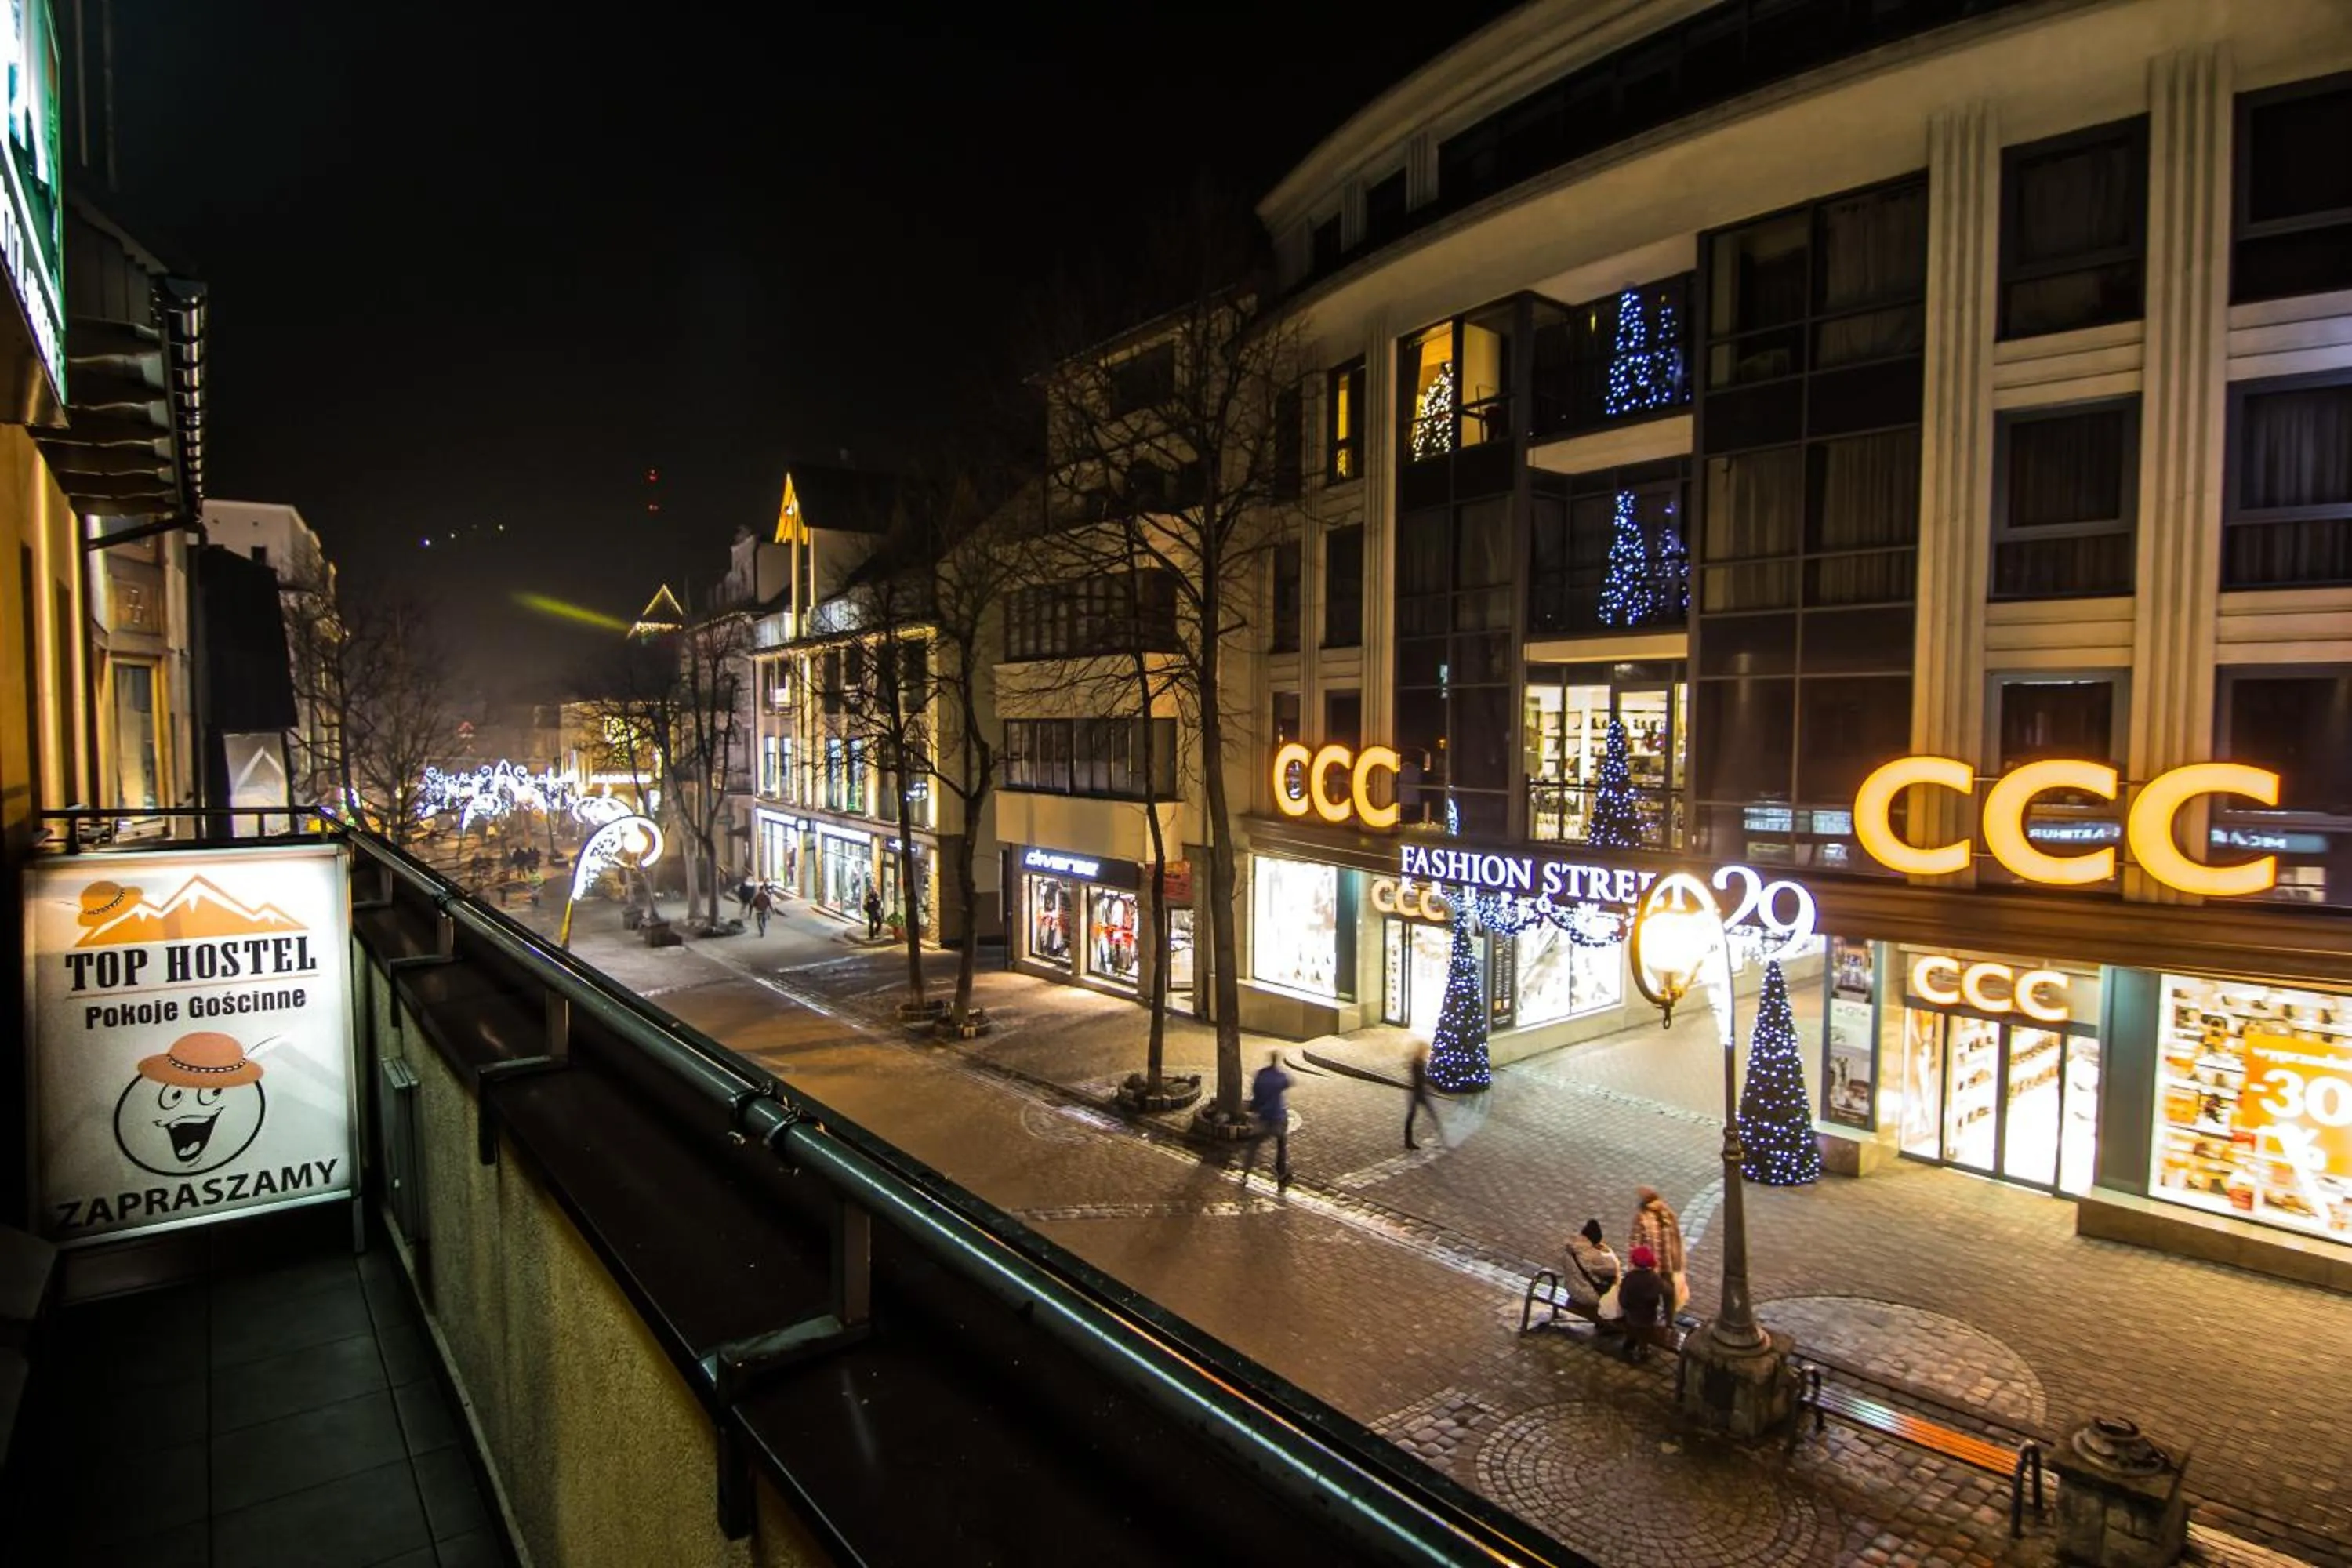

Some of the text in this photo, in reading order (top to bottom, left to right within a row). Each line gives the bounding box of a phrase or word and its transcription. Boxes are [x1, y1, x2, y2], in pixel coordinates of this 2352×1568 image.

[1273, 742, 1401, 828] CCC
[1853, 756, 2280, 896] CCC
[1372, 879, 1444, 921] CCC
[1400, 845, 1532, 891] FASHION
[1712, 865, 1817, 956] 29
[65, 936, 316, 991] TOP HOSTEL
[1913, 956, 2070, 1022] CCC
[85, 988, 306, 1030] Pokoje Gościnne
[57, 1158, 338, 1229] ZAPRASZAMY
